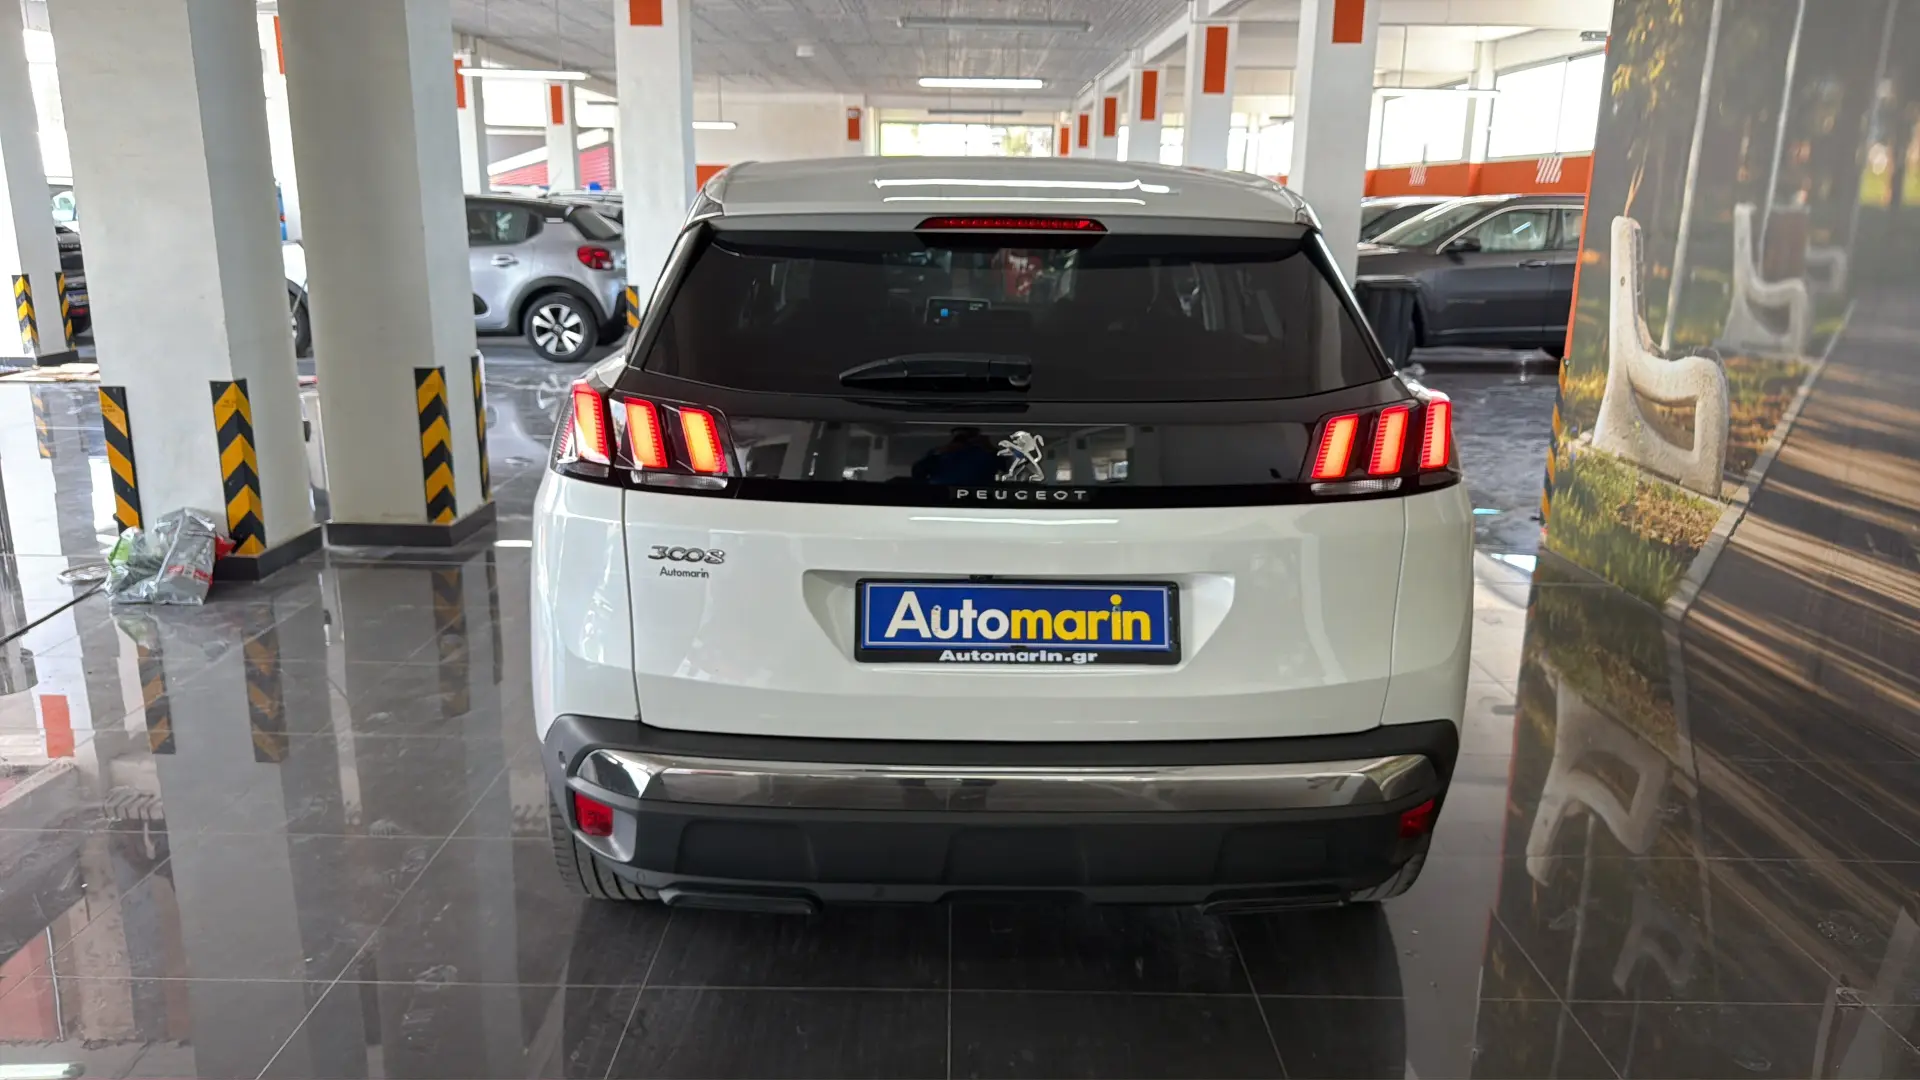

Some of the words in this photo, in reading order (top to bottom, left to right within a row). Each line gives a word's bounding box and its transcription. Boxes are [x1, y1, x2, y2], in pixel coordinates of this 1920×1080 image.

[957, 489, 1086, 500] PEUGEOT
[648, 545, 725, 564] 3008
[660, 566, 709, 578] Automarin
[884, 590, 1151, 641] Automarin
[939, 650, 1098, 664] Automarin.gr
